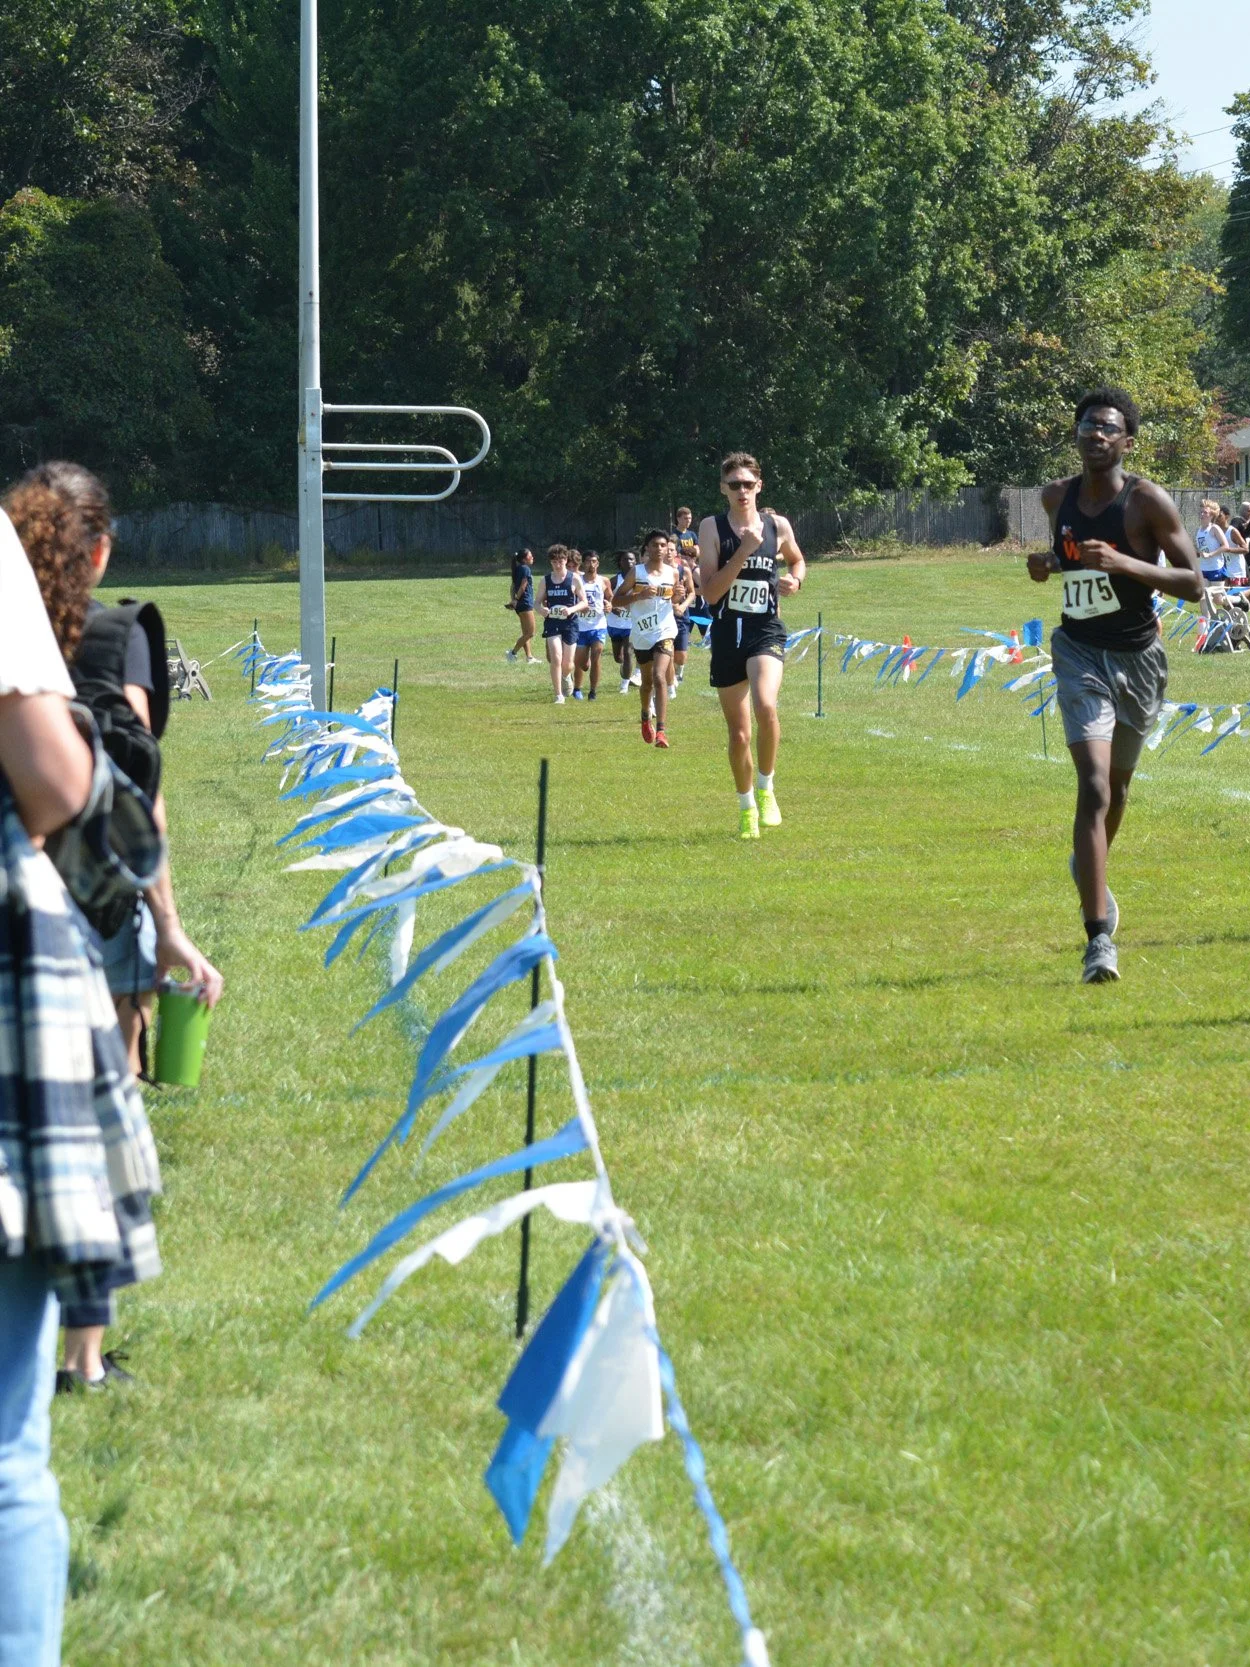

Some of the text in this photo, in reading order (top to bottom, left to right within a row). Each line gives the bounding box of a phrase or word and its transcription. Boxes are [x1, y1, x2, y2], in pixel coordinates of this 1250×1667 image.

[726, 556, 774, 572] STACE
[731, 585, 767, 605] 1709
[1064, 576, 1113, 608] 1775
[637, 614, 659, 632] 1877
